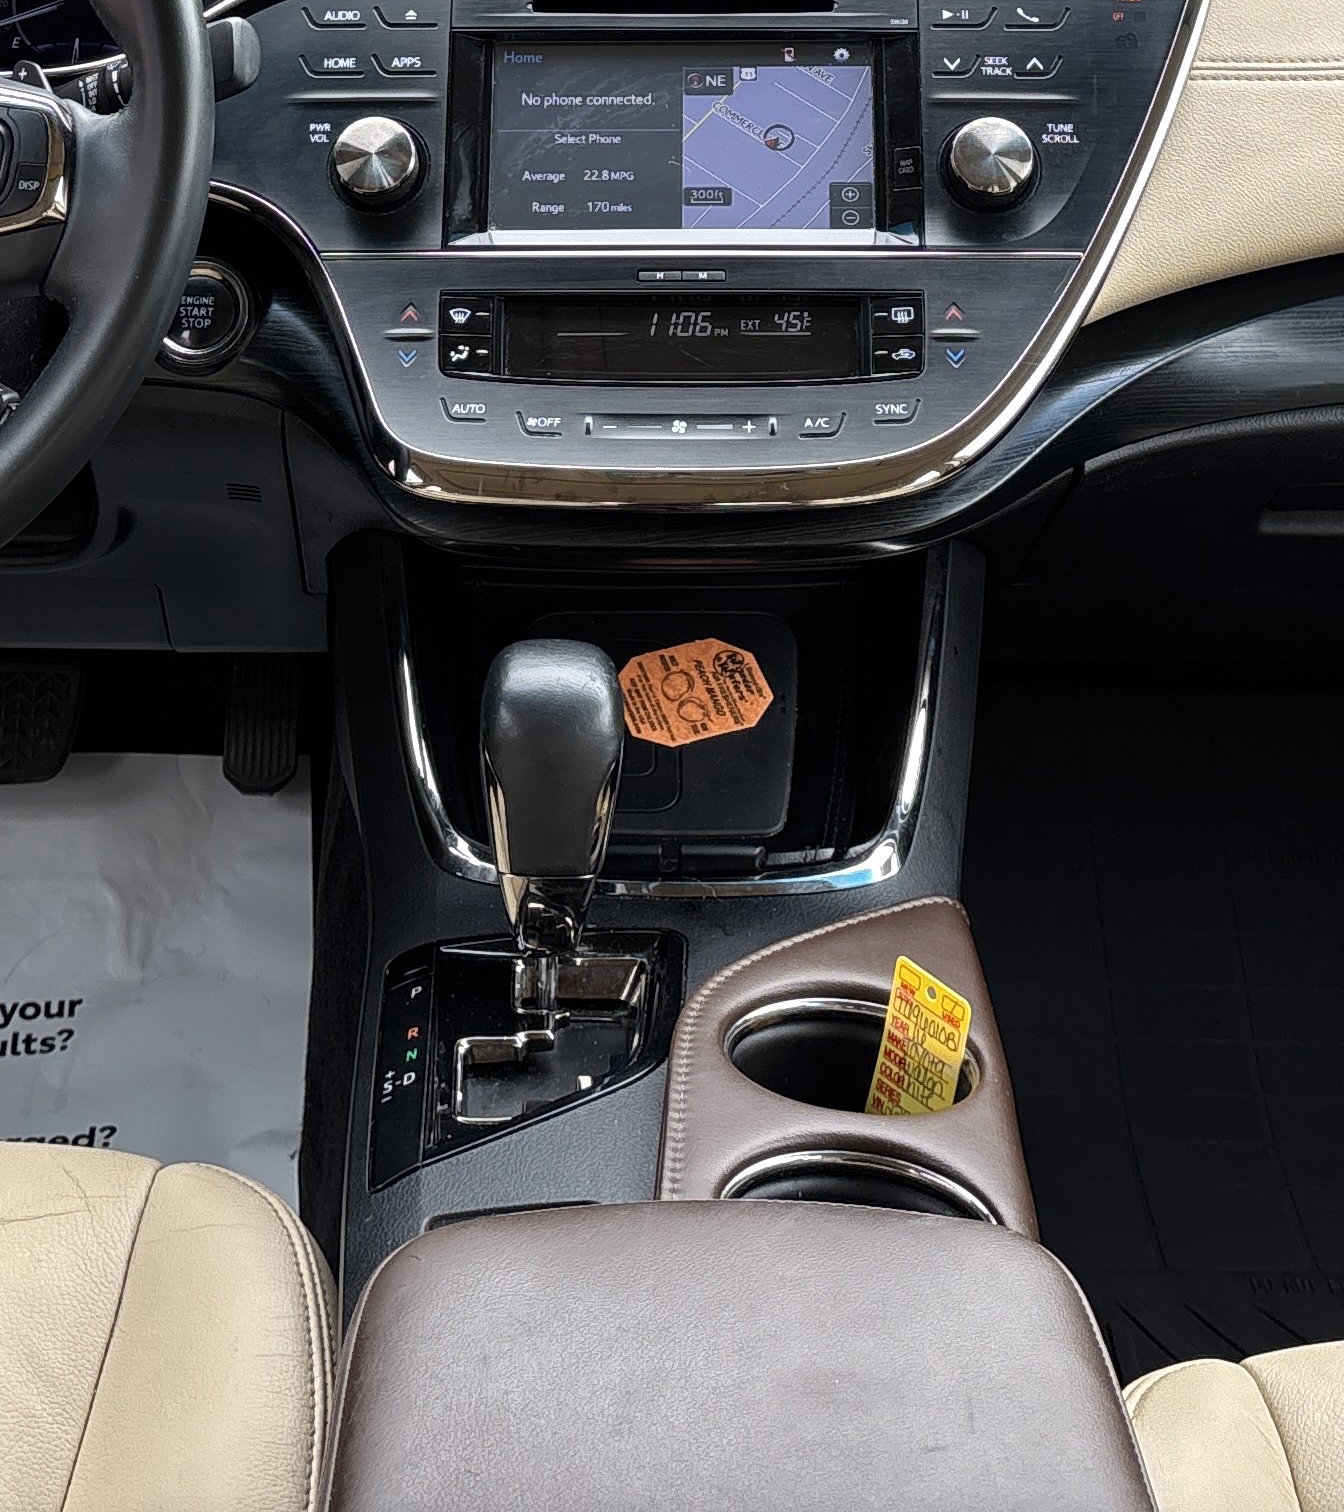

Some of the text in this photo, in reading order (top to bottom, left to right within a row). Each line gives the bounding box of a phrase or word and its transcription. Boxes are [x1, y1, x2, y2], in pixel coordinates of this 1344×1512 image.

[324, 10, 361, 21] AUDIO
[11, 37, 21, 49] E
[323, 57, 357, 69] HOME
[392, 57, 422, 69] APPS
[504, 51, 543, 64] Home
[984, 57, 1009, 66] SEEK
[981, 67, 1013, 76] TRACK
[706, 75, 727, 87] NE
[521, 93, 656, 108] No phone connected.
[309, 123, 332, 133] PWR
[1047, 124, 1074, 134] TUNE
[309, 134, 330, 144] VOL
[554, 133, 622, 144] Select Phone
[1042, 134, 1080, 144] SCROLL
[522, 170, 566, 184] Average
[18, 180, 40, 190] DISP
[690, 189, 724, 199] 300ft
[532, 202, 565, 215] Range
[181, 295, 215, 306] ENGINE
[179, 307, 216, 317] START
[181, 318, 212, 329] STOP
[740, 319, 761, 331] EXT
[714, 329, 729, 337] PM
[452, 403, 486, 414] AUTO
[875, 402, 909, 415] SYNC
[803, 416, 831, 430] A/C
[694, 660, 726, 716] PEACH MANGO
[411, 986, 422, 999] P
[891, 1013, 909, 1037] YEAR
[942, 1011, 960, 1029] USED
[407, 1027, 419, 1040] R
[887, 1029, 907, 1052] MAKE
[406, 1048, 418, 1062] N
[403, 1072, 416, 1086] D
[383, 1079, 394, 1094] S
